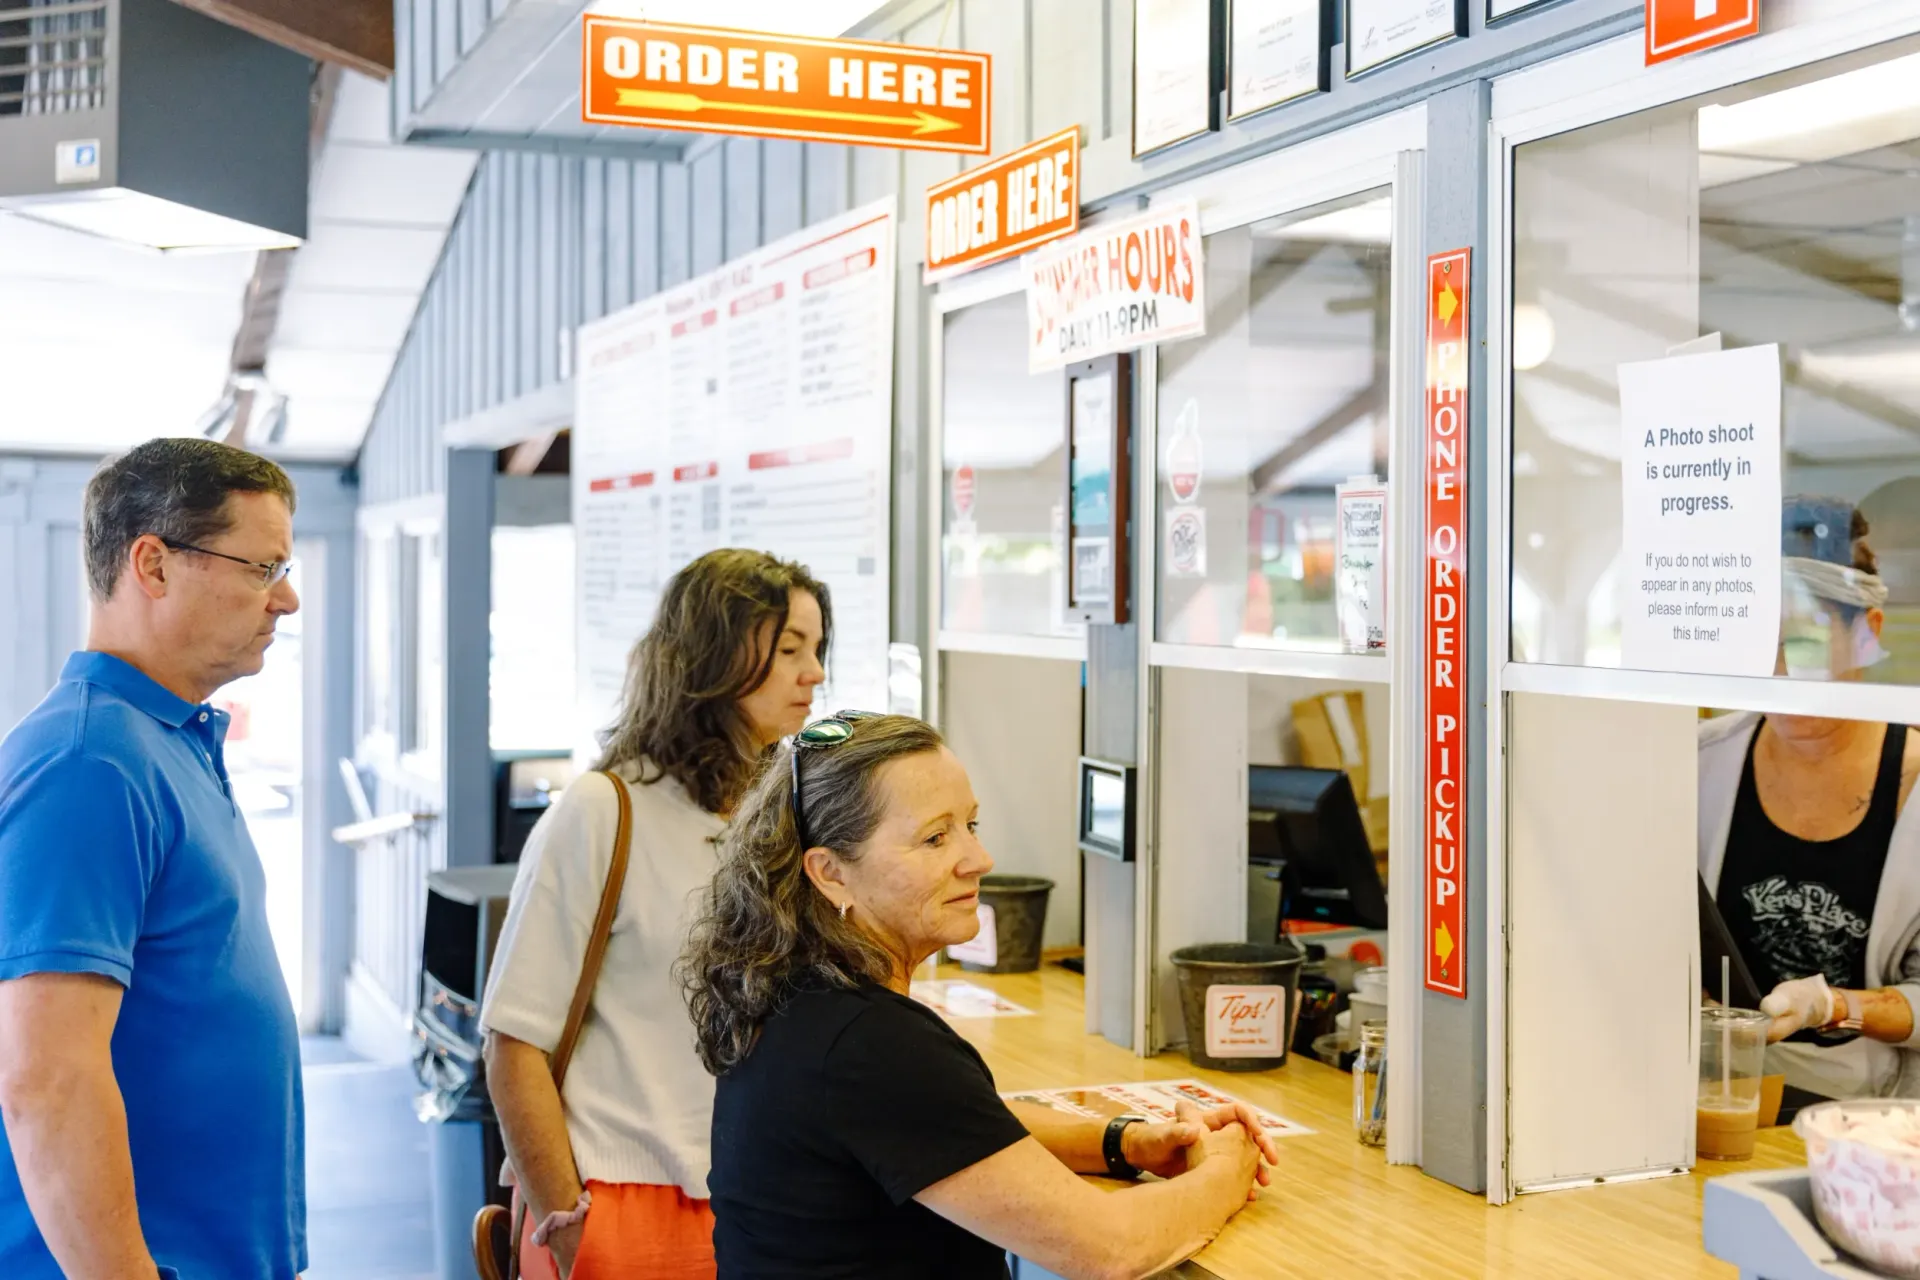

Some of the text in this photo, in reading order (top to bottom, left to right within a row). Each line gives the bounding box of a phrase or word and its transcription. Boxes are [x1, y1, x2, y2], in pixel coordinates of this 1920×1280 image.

[603, 36, 972, 109] ORDER HERE
[930, 148, 1070, 264] ORDER HERE
[1107, 218, 1194, 304] HOURS
[1059, 298, 1159, 354] DAILY 11-9PM
[1644, 422, 1754, 448] A Photo shoot
[1646, 456, 1751, 481] is currently in
[1661, 495, 1733, 516] progress.
[1645, 552, 1752, 571] If you do not wish to
[1641, 577, 1756, 596] appear in any photos,
[1433, 341, 1458, 906] PHONE ORDER PICKUP
[1648, 600, 1748, 618] please inform us at
[1673, 625, 1720, 642] this time!
[1800, 884, 1867, 933] Place
[1219, 994, 1276, 1026] Tips!
